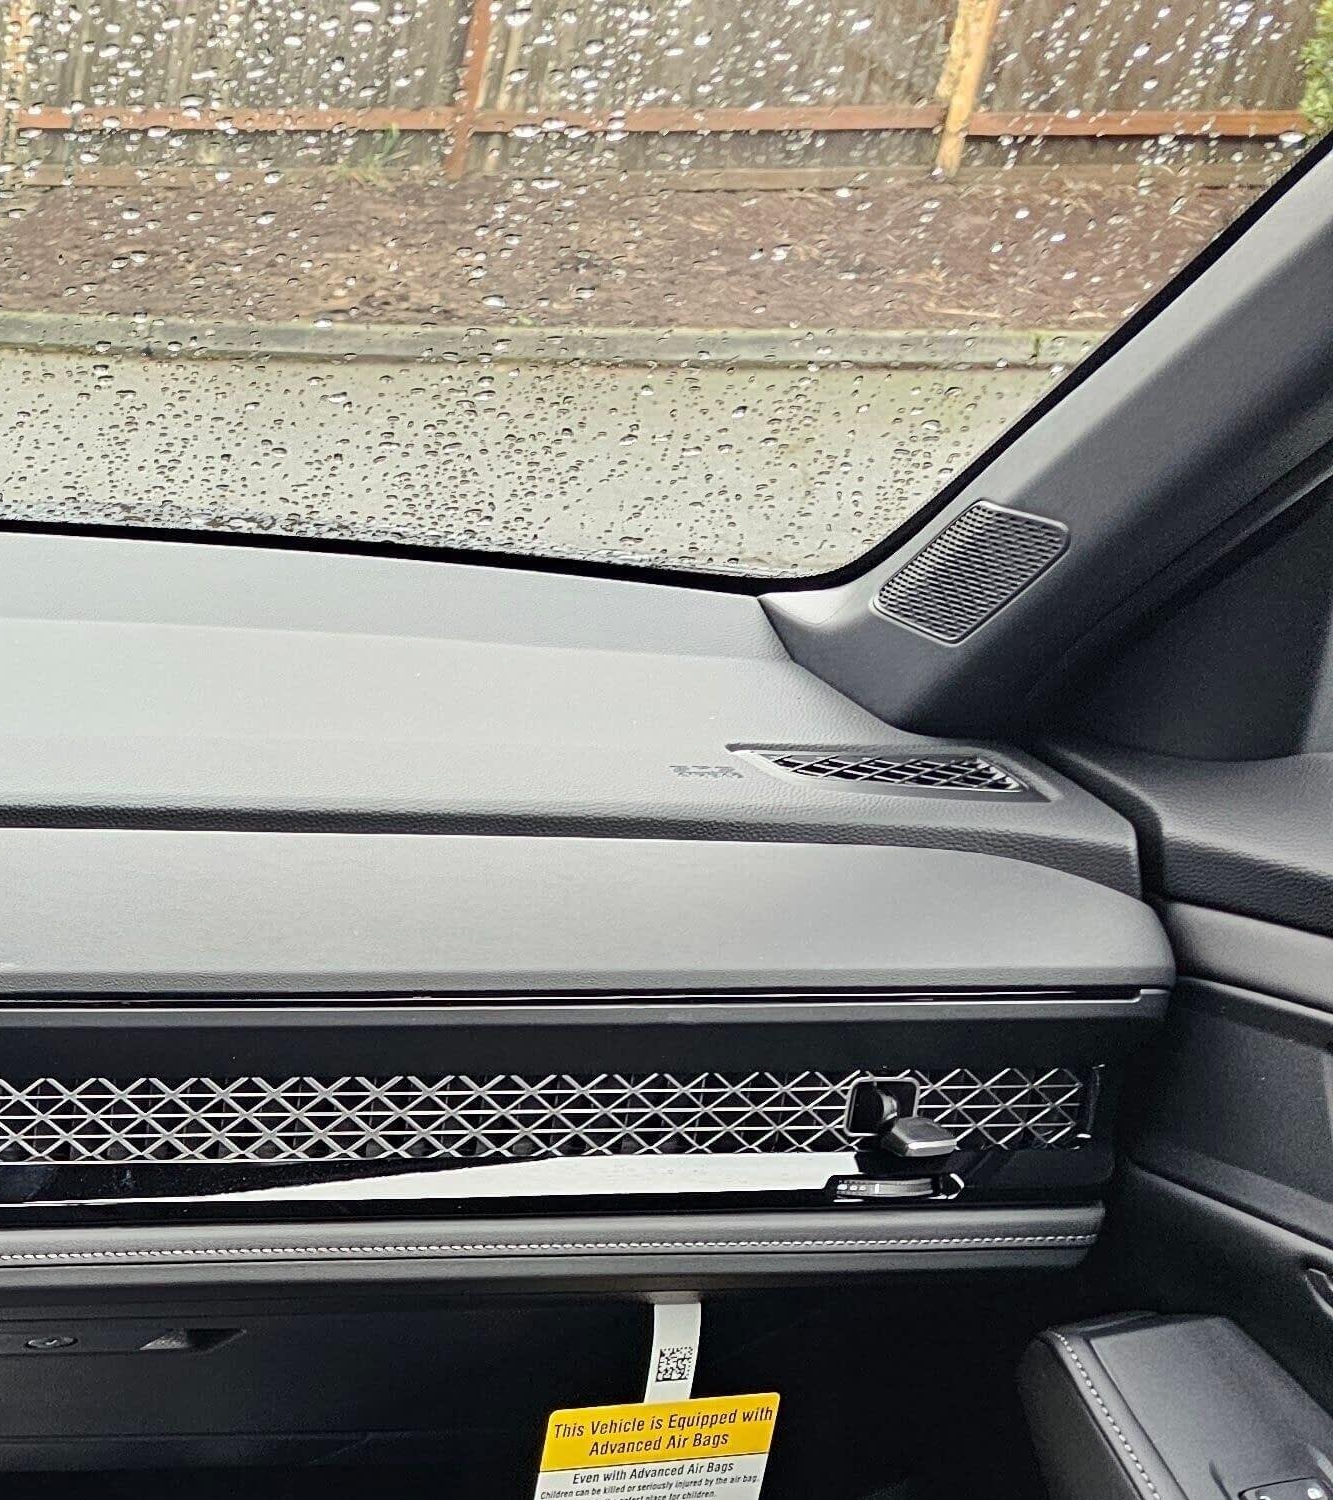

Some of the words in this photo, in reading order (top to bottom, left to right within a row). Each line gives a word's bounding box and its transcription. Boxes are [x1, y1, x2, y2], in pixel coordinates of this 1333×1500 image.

[555, 1423, 584, 1438] This
[591, 1419, 644, 1435] Vehicle
[650, 1416, 663, 1430] is
[668, 1410, 737, 1430] Equipped
[743, 1407, 773, 1421] with
[589, 1436, 662, 1456] Advanced
[666, 1434, 688, 1449] Air
[693, 1433, 729, 1448] Bags
[573, 1473, 599, 1484] Even
[604, 1469, 626, 1481] with
[630, 1464, 685, 1479] Advanced
[687, 1464, 704, 1474] Air
[707, 1462, 734, 1474] Bags
[540, 1488, 573, 1500] Children
[575, 1489, 589, 1497] can
[592, 1486, 601, 1495] be
[603, 1484, 625, 1495] killed
[627, 1484, 635, 1492] or
[637, 1480, 673, 1491] seriously
[675, 1479, 702, 1489] injured
[704, 1477, 713, 1487] by
[715, 1476, 727, 1485] the
[668, 1493, 680, 1500] for
[682, 1490, 716, 1499] children.
